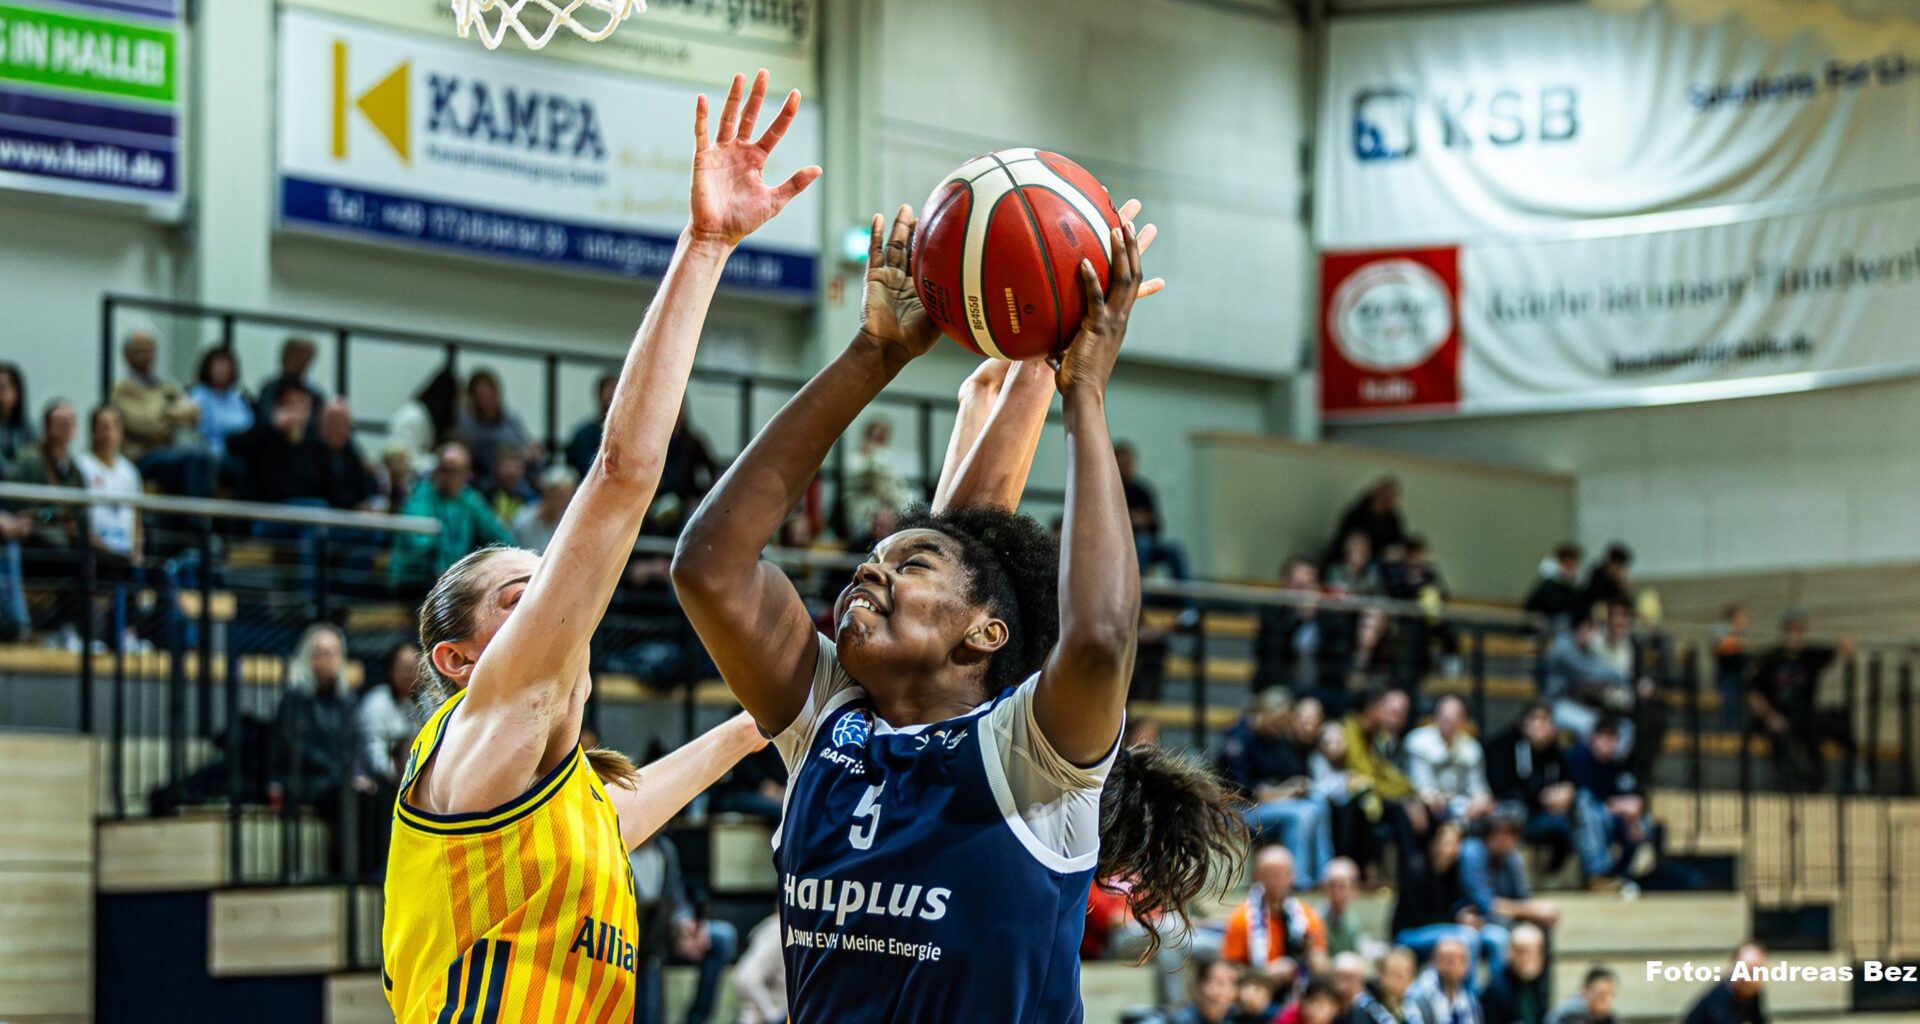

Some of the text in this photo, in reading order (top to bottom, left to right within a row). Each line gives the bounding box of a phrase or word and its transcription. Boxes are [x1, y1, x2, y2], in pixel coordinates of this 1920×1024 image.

[427, 73, 606, 160] KAMPA
[1436, 84, 1579, 149] KSB
[819, 747, 856, 768] RAFT
[848, 780, 886, 850] 5
[816, 932, 839, 949] EVH
[842, 934, 885, 953] Meine
[888, 938, 942, 961] Energie
